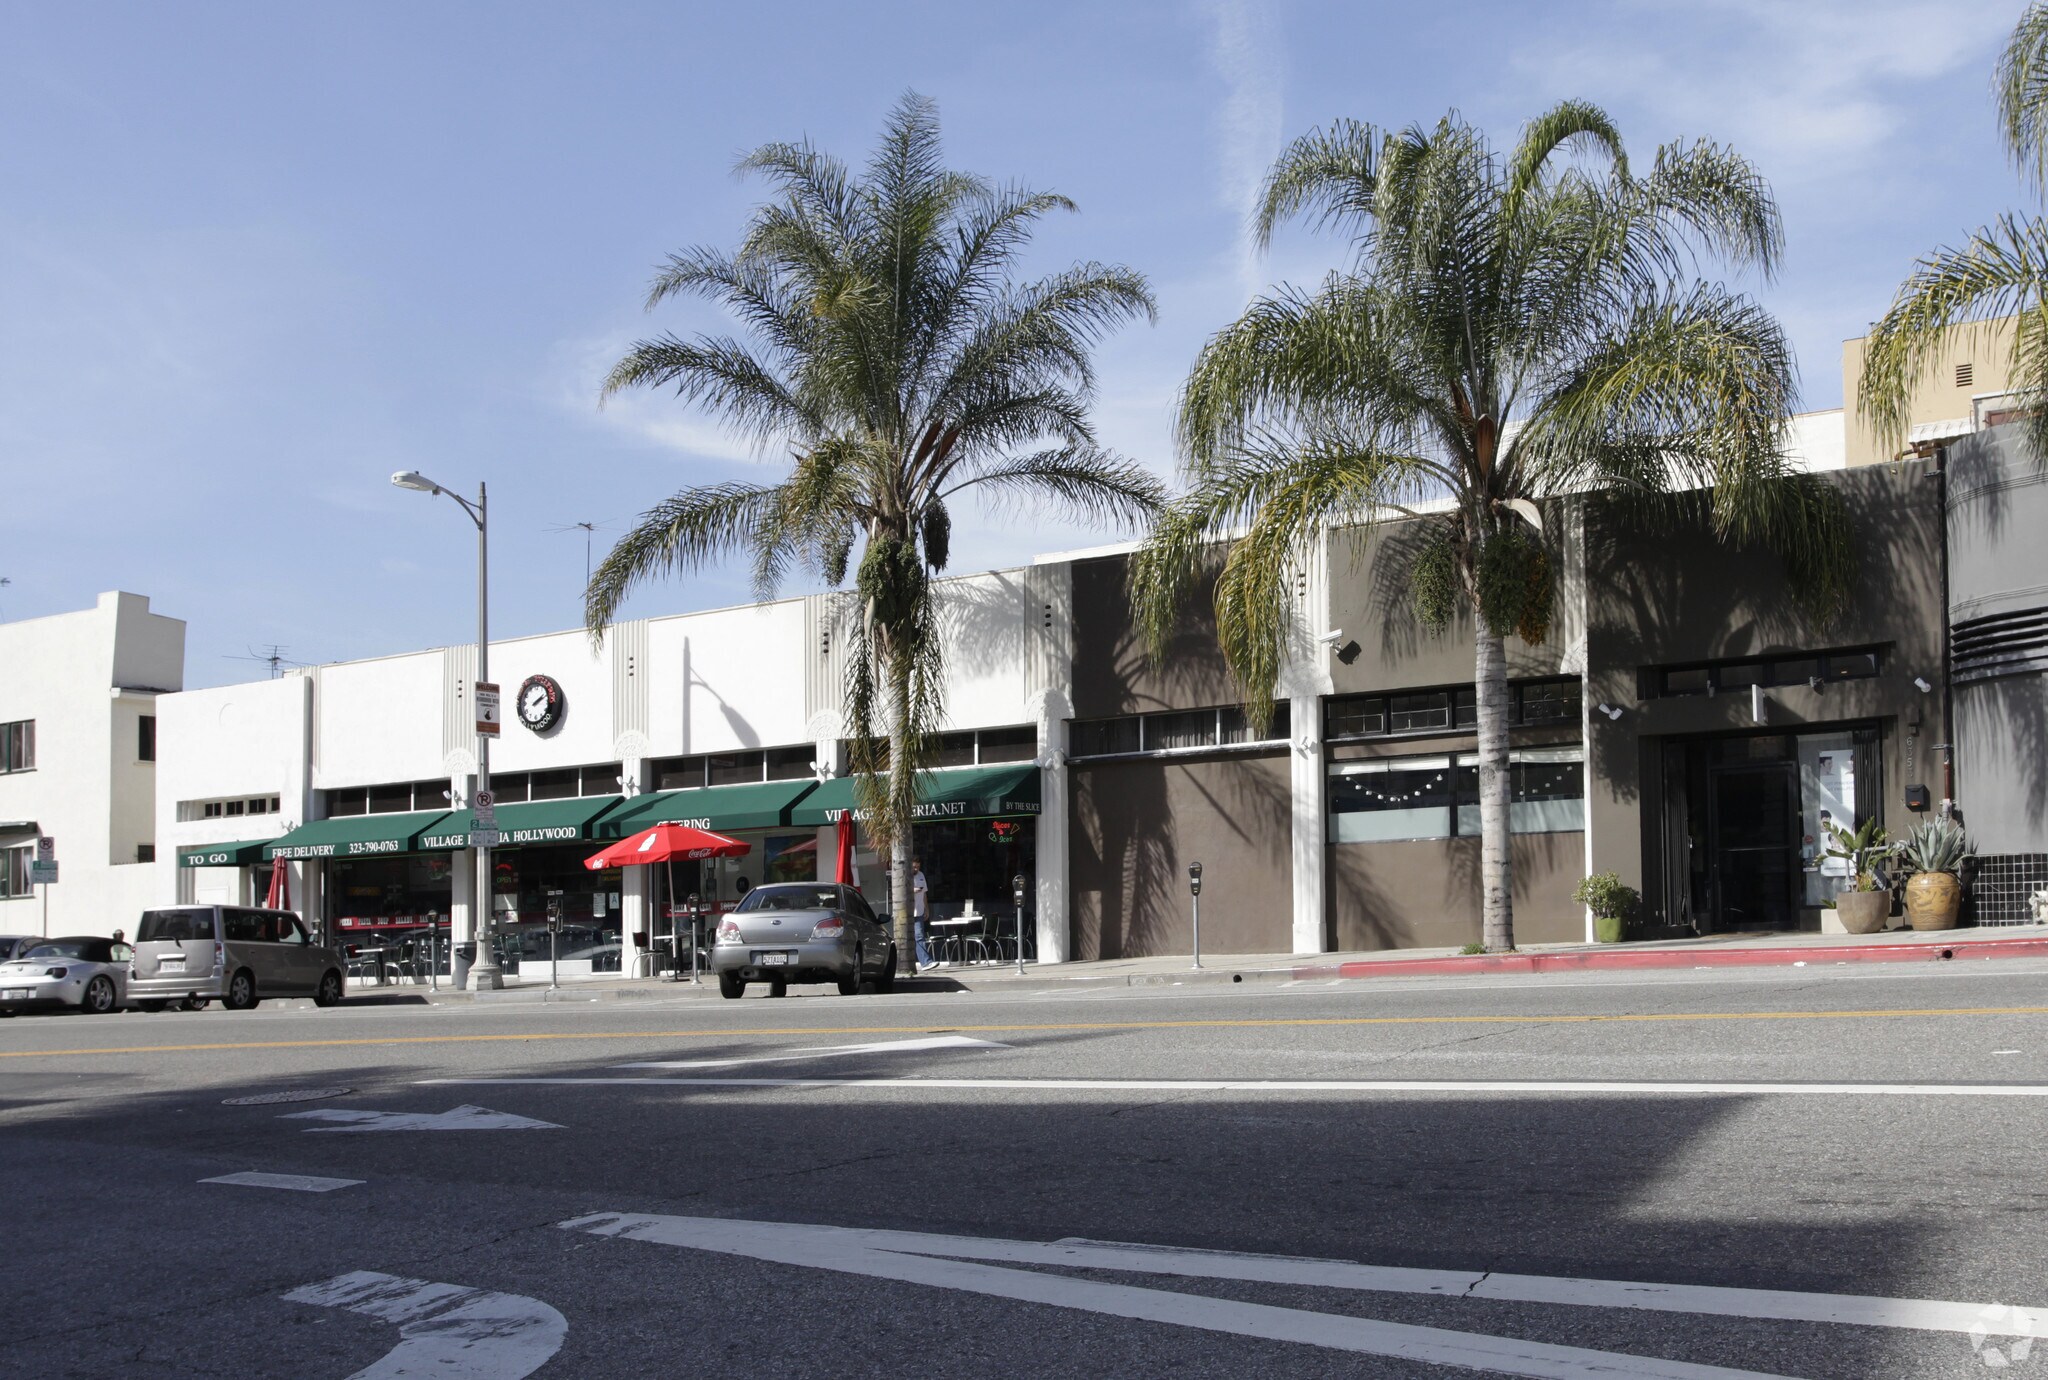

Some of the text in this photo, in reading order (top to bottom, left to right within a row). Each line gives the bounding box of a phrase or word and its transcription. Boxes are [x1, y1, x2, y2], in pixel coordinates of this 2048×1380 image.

[1006, 801, 1040, 812] BY THE SLICE
[513, 826, 577, 842] HOLLYWOOD
[349, 840, 399, 854] 323-790-0763
[424, 835, 464, 848] VILLAGE
[272, 844, 336, 859] FREE DELIVERY
[188, 853, 228, 865] TO GO
